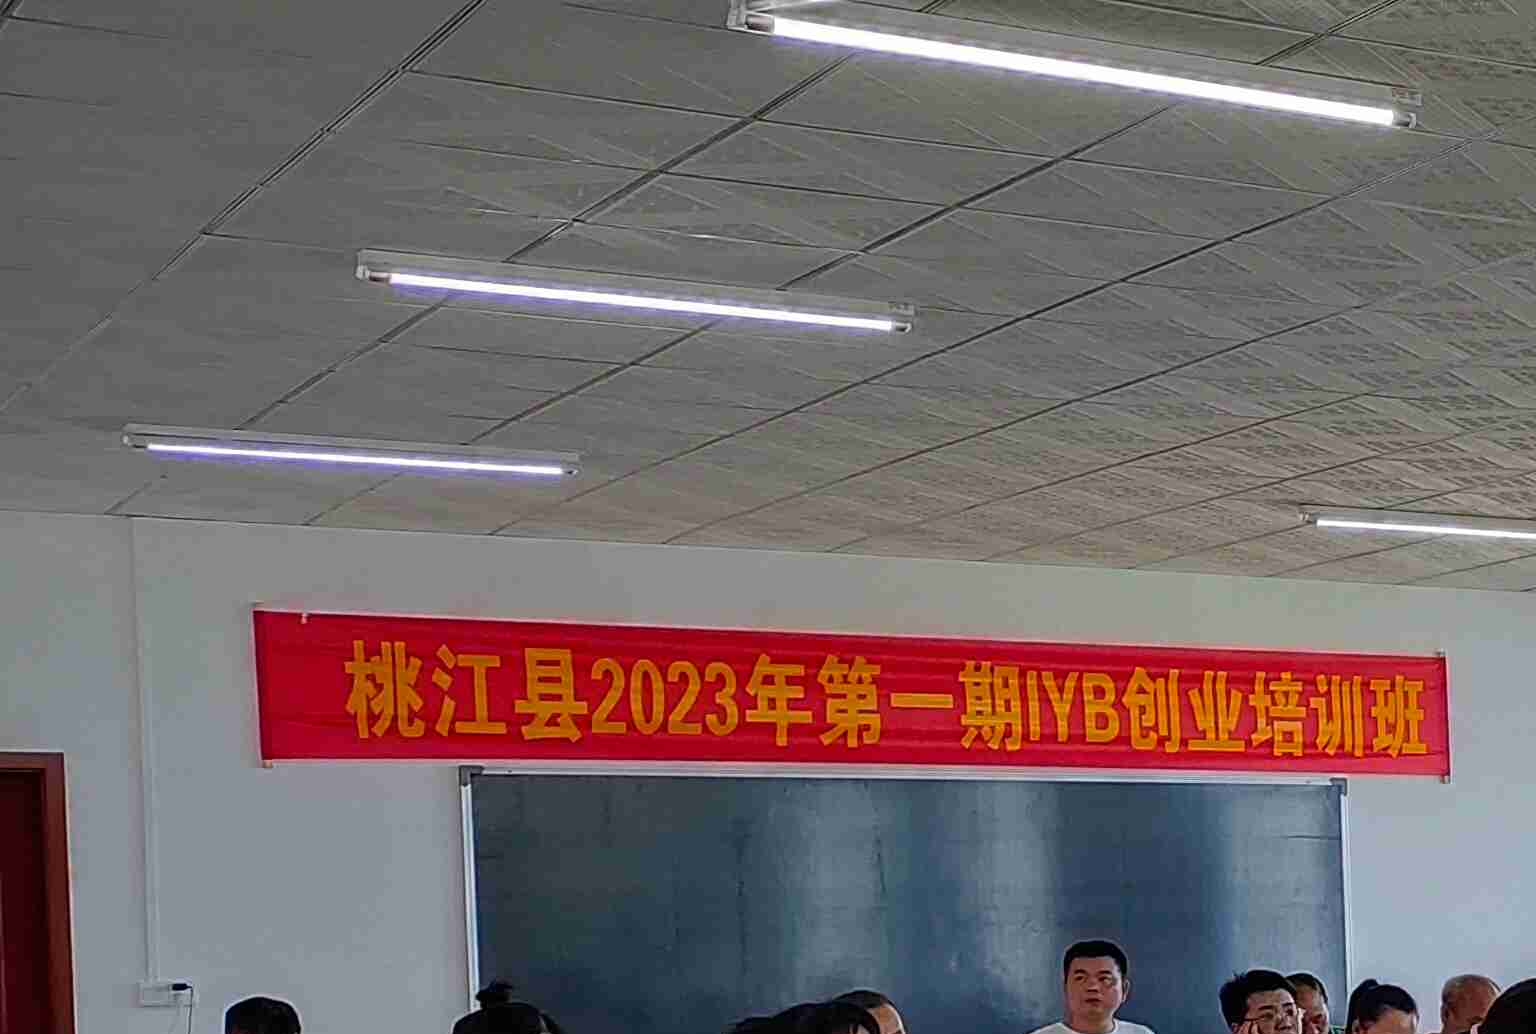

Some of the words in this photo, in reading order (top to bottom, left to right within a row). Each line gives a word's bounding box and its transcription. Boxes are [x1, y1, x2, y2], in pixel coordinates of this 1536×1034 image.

[345, 639, 1428, 759] 桃江县2023年第一期IYB创业培训班
